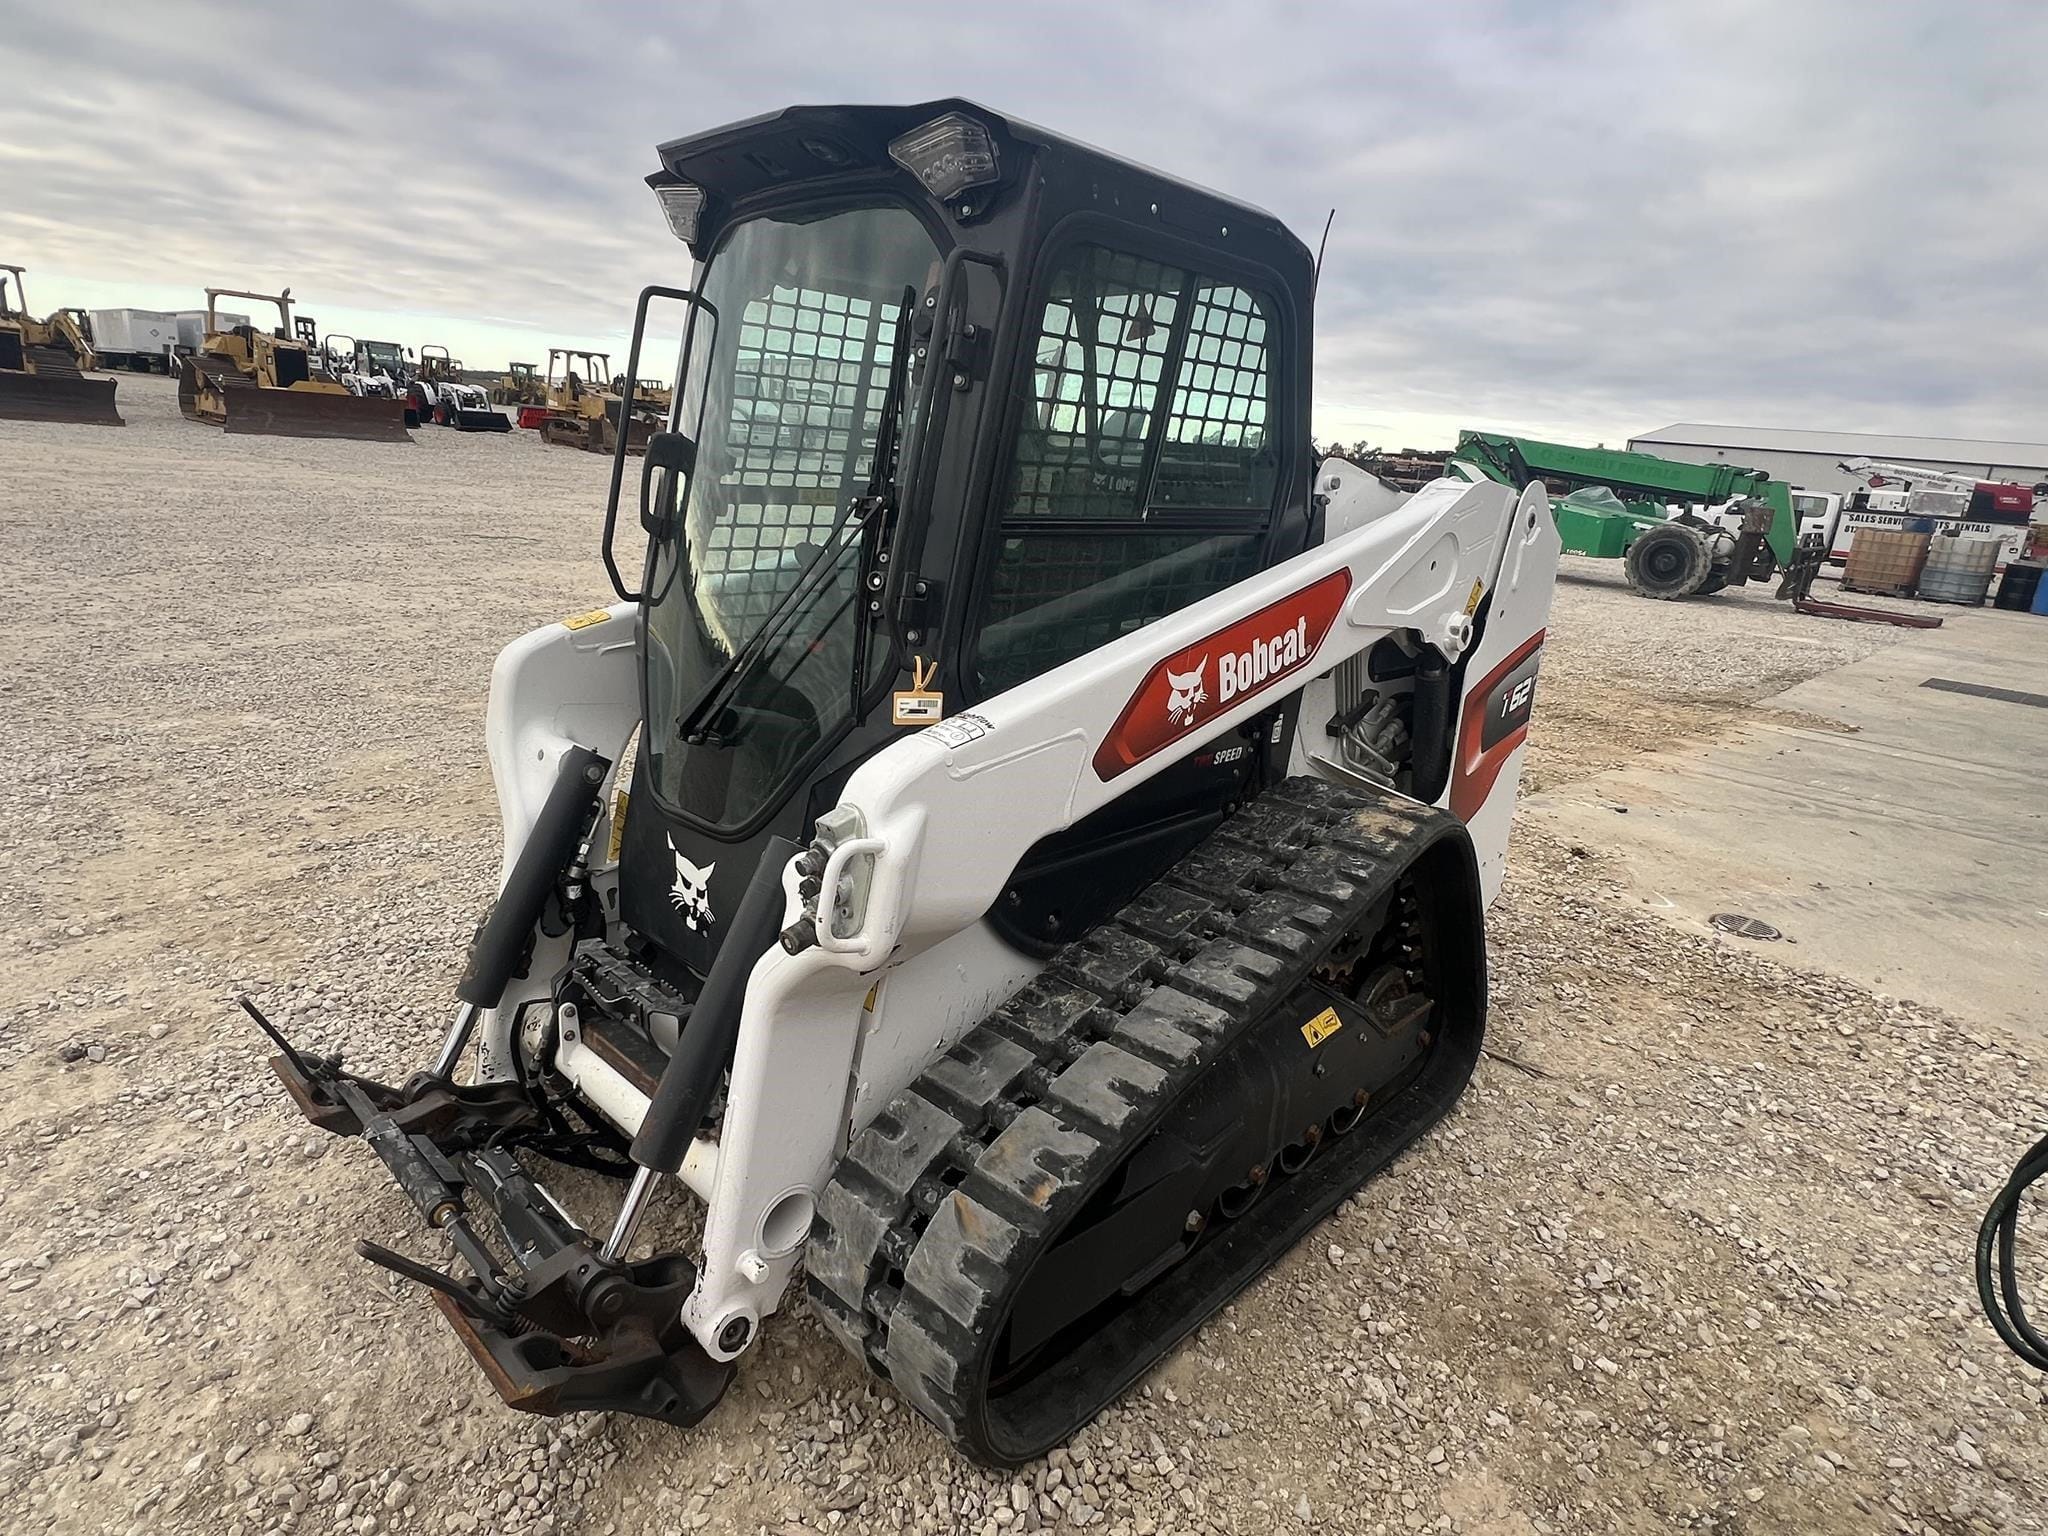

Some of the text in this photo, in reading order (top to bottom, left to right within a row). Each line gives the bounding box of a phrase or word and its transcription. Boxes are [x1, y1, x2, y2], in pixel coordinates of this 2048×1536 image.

[1848, 513, 1876, 524] SALES
[1219, 615, 1306, 703] Bobcat
[1213, 746, 1243, 765] SPEED
